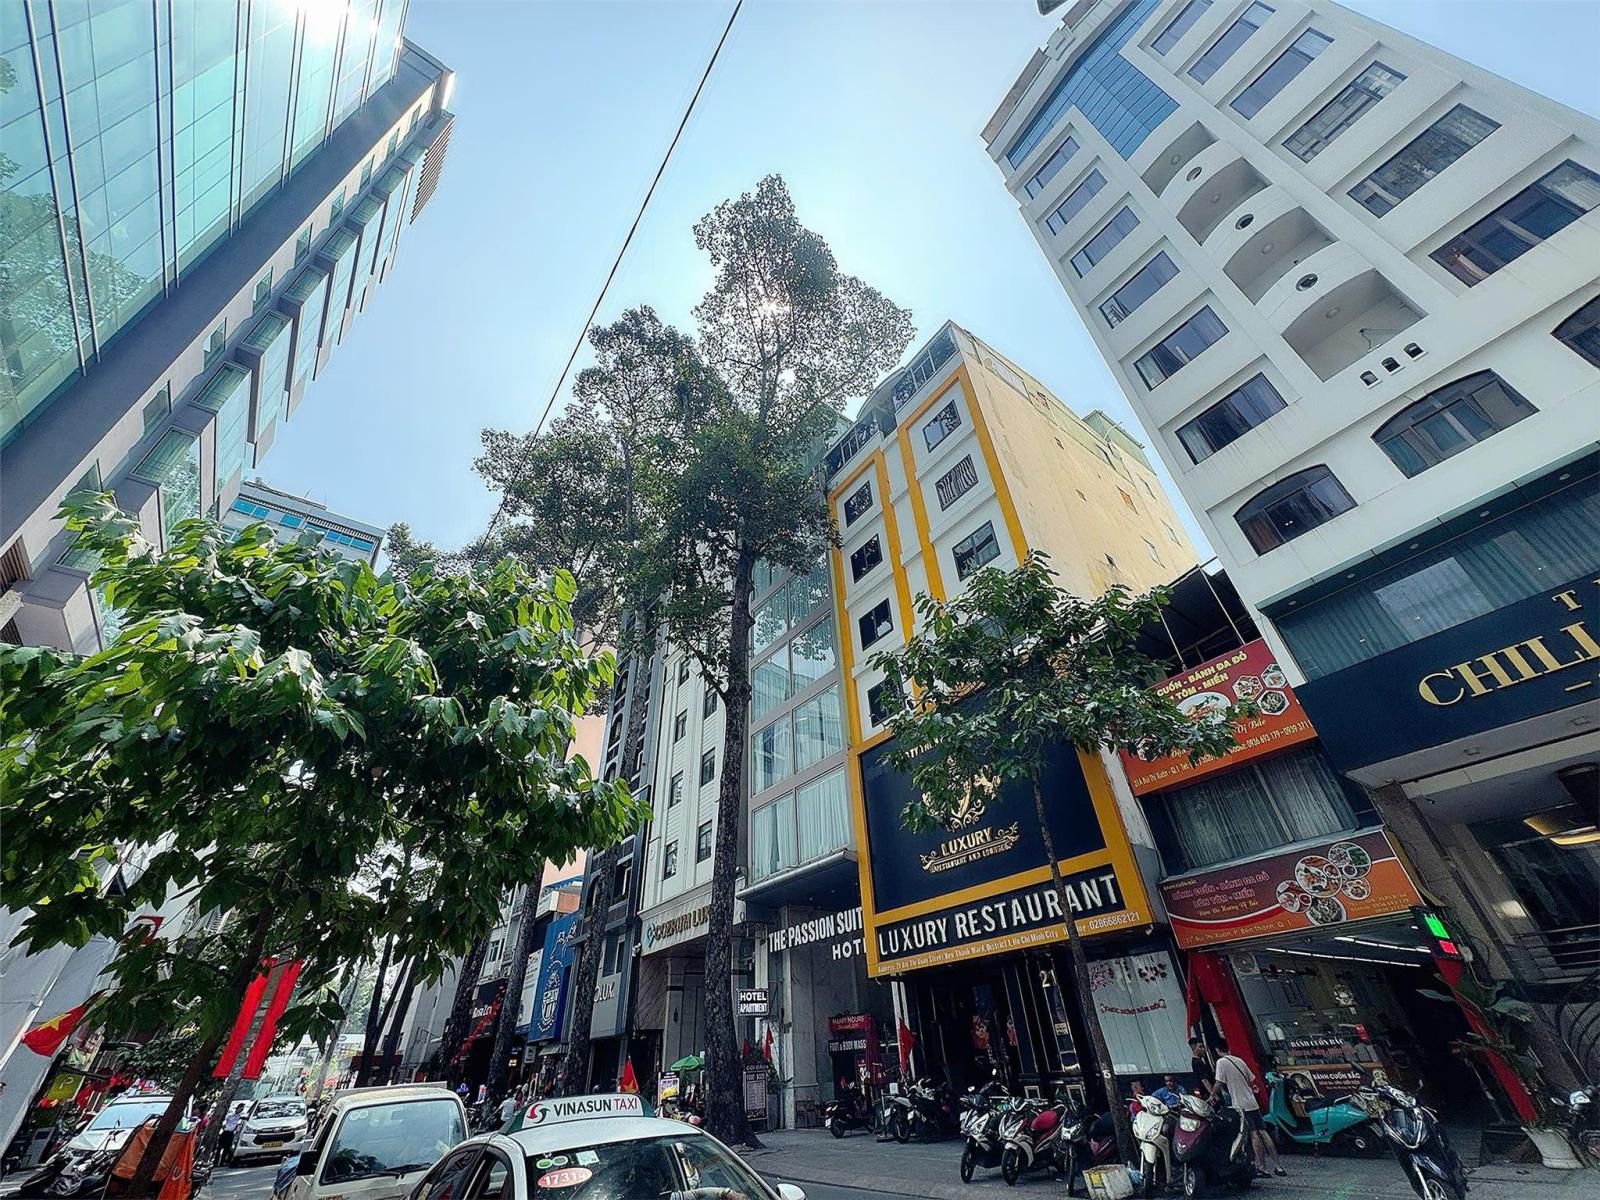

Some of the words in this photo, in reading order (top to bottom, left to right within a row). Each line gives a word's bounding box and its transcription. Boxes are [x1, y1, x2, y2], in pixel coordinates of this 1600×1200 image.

[1156, 680, 1183, 697] CUỐN
[1188, 667, 1216, 684] BÁNH
[1231, 649, 1248, 664] ĐỎ
[1202, 672, 1229, 689] MIẾN
[940, 826, 993, 857] LUXURY
[878, 916, 948, 956] LUXURY
[955, 873, 1119, 940] RESTAURANT
[768, 929, 787, 953] THE
[788, 915, 835, 948] PASSION
[740, 991, 767, 1001] HOTEL
[740, 1002, 767, 1014] APARTMENT
[554, 1098, 611, 1117] VINASUN
[614, 1097, 638, 1111] TAXI
[543, 1172, 587, 1186] 17314
